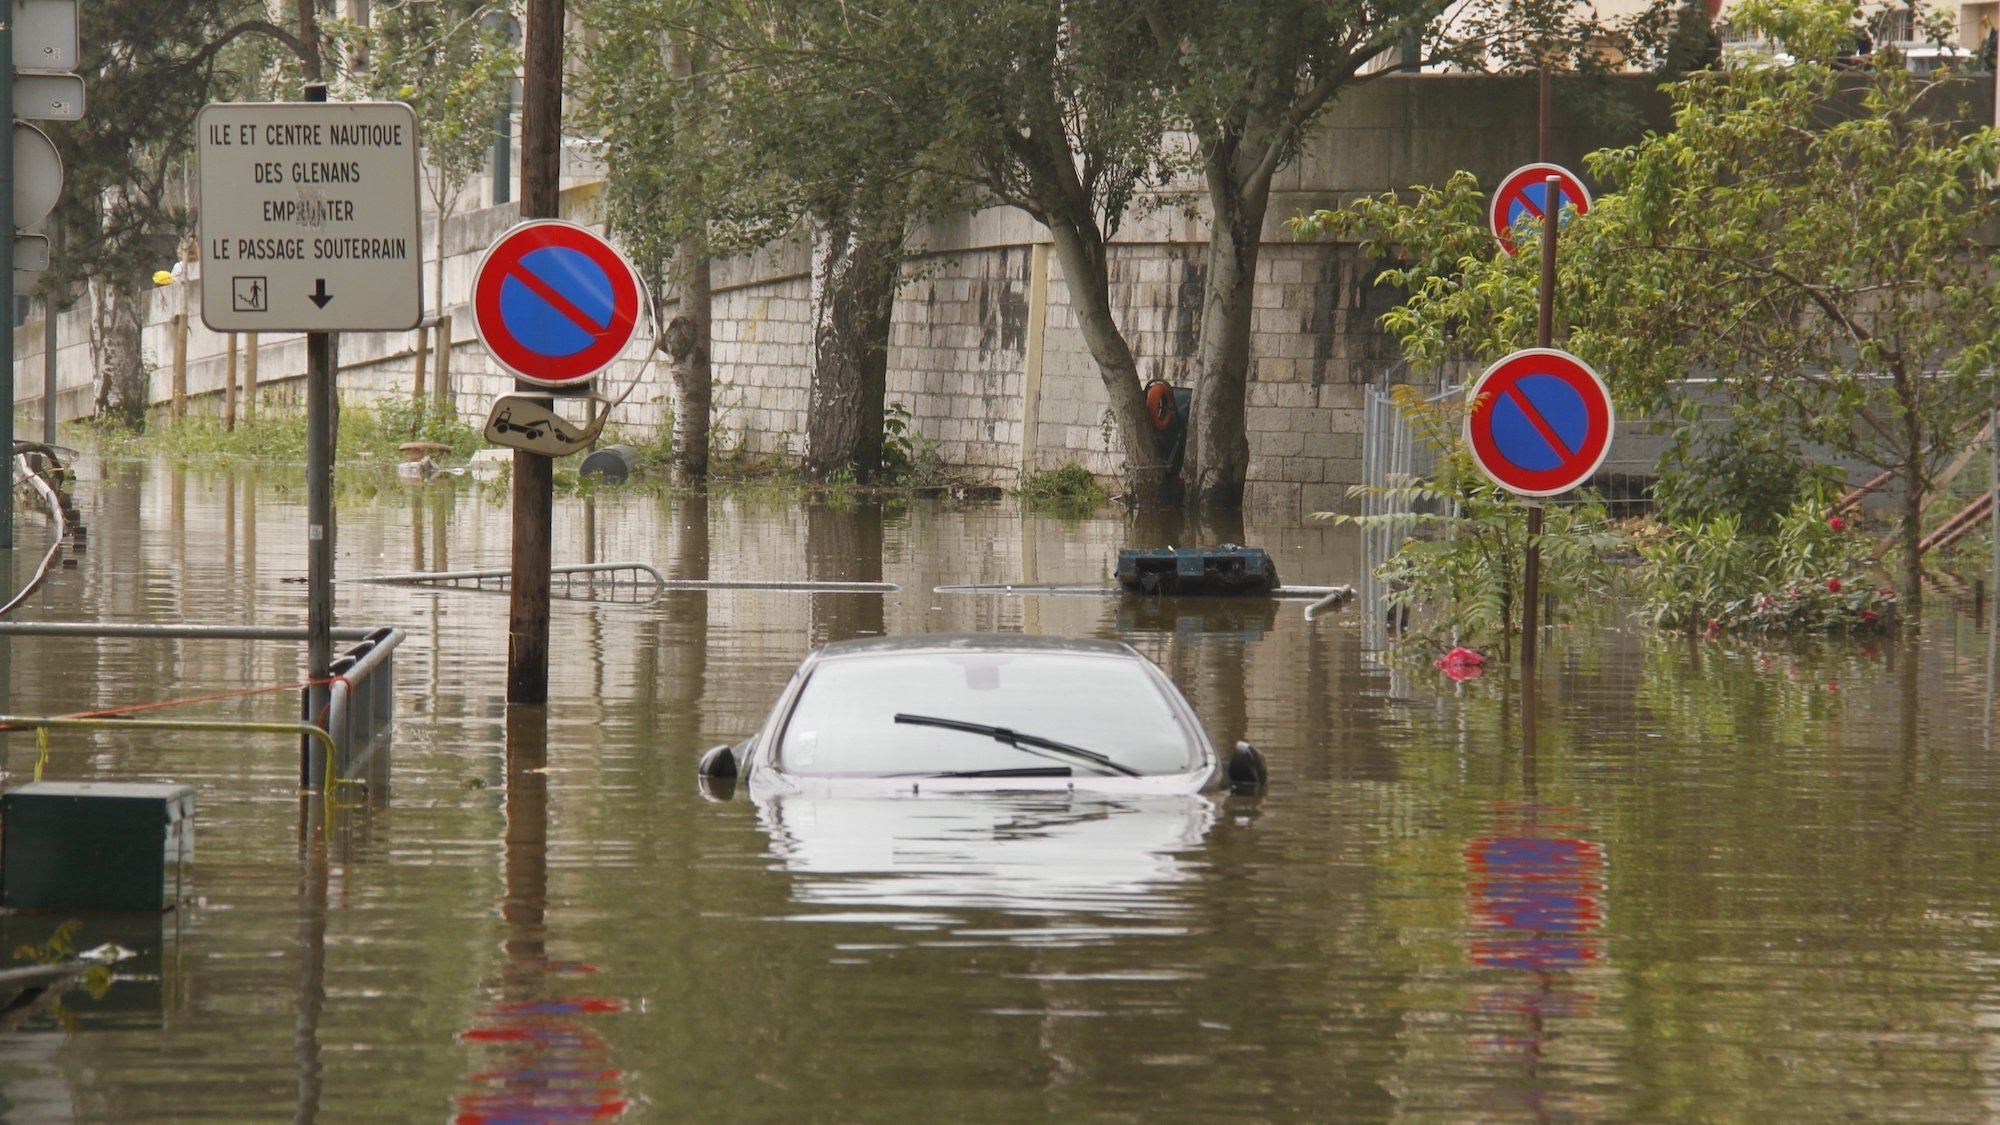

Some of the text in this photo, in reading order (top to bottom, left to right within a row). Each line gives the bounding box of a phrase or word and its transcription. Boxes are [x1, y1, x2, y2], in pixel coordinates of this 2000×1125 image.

[209, 124, 403, 149] ILE ET CENTRE NAUTIQUE
[254, 161, 361, 184] DES GLENANS
[212, 237, 406, 260] LE PASSAGE SOUTERRAIN
